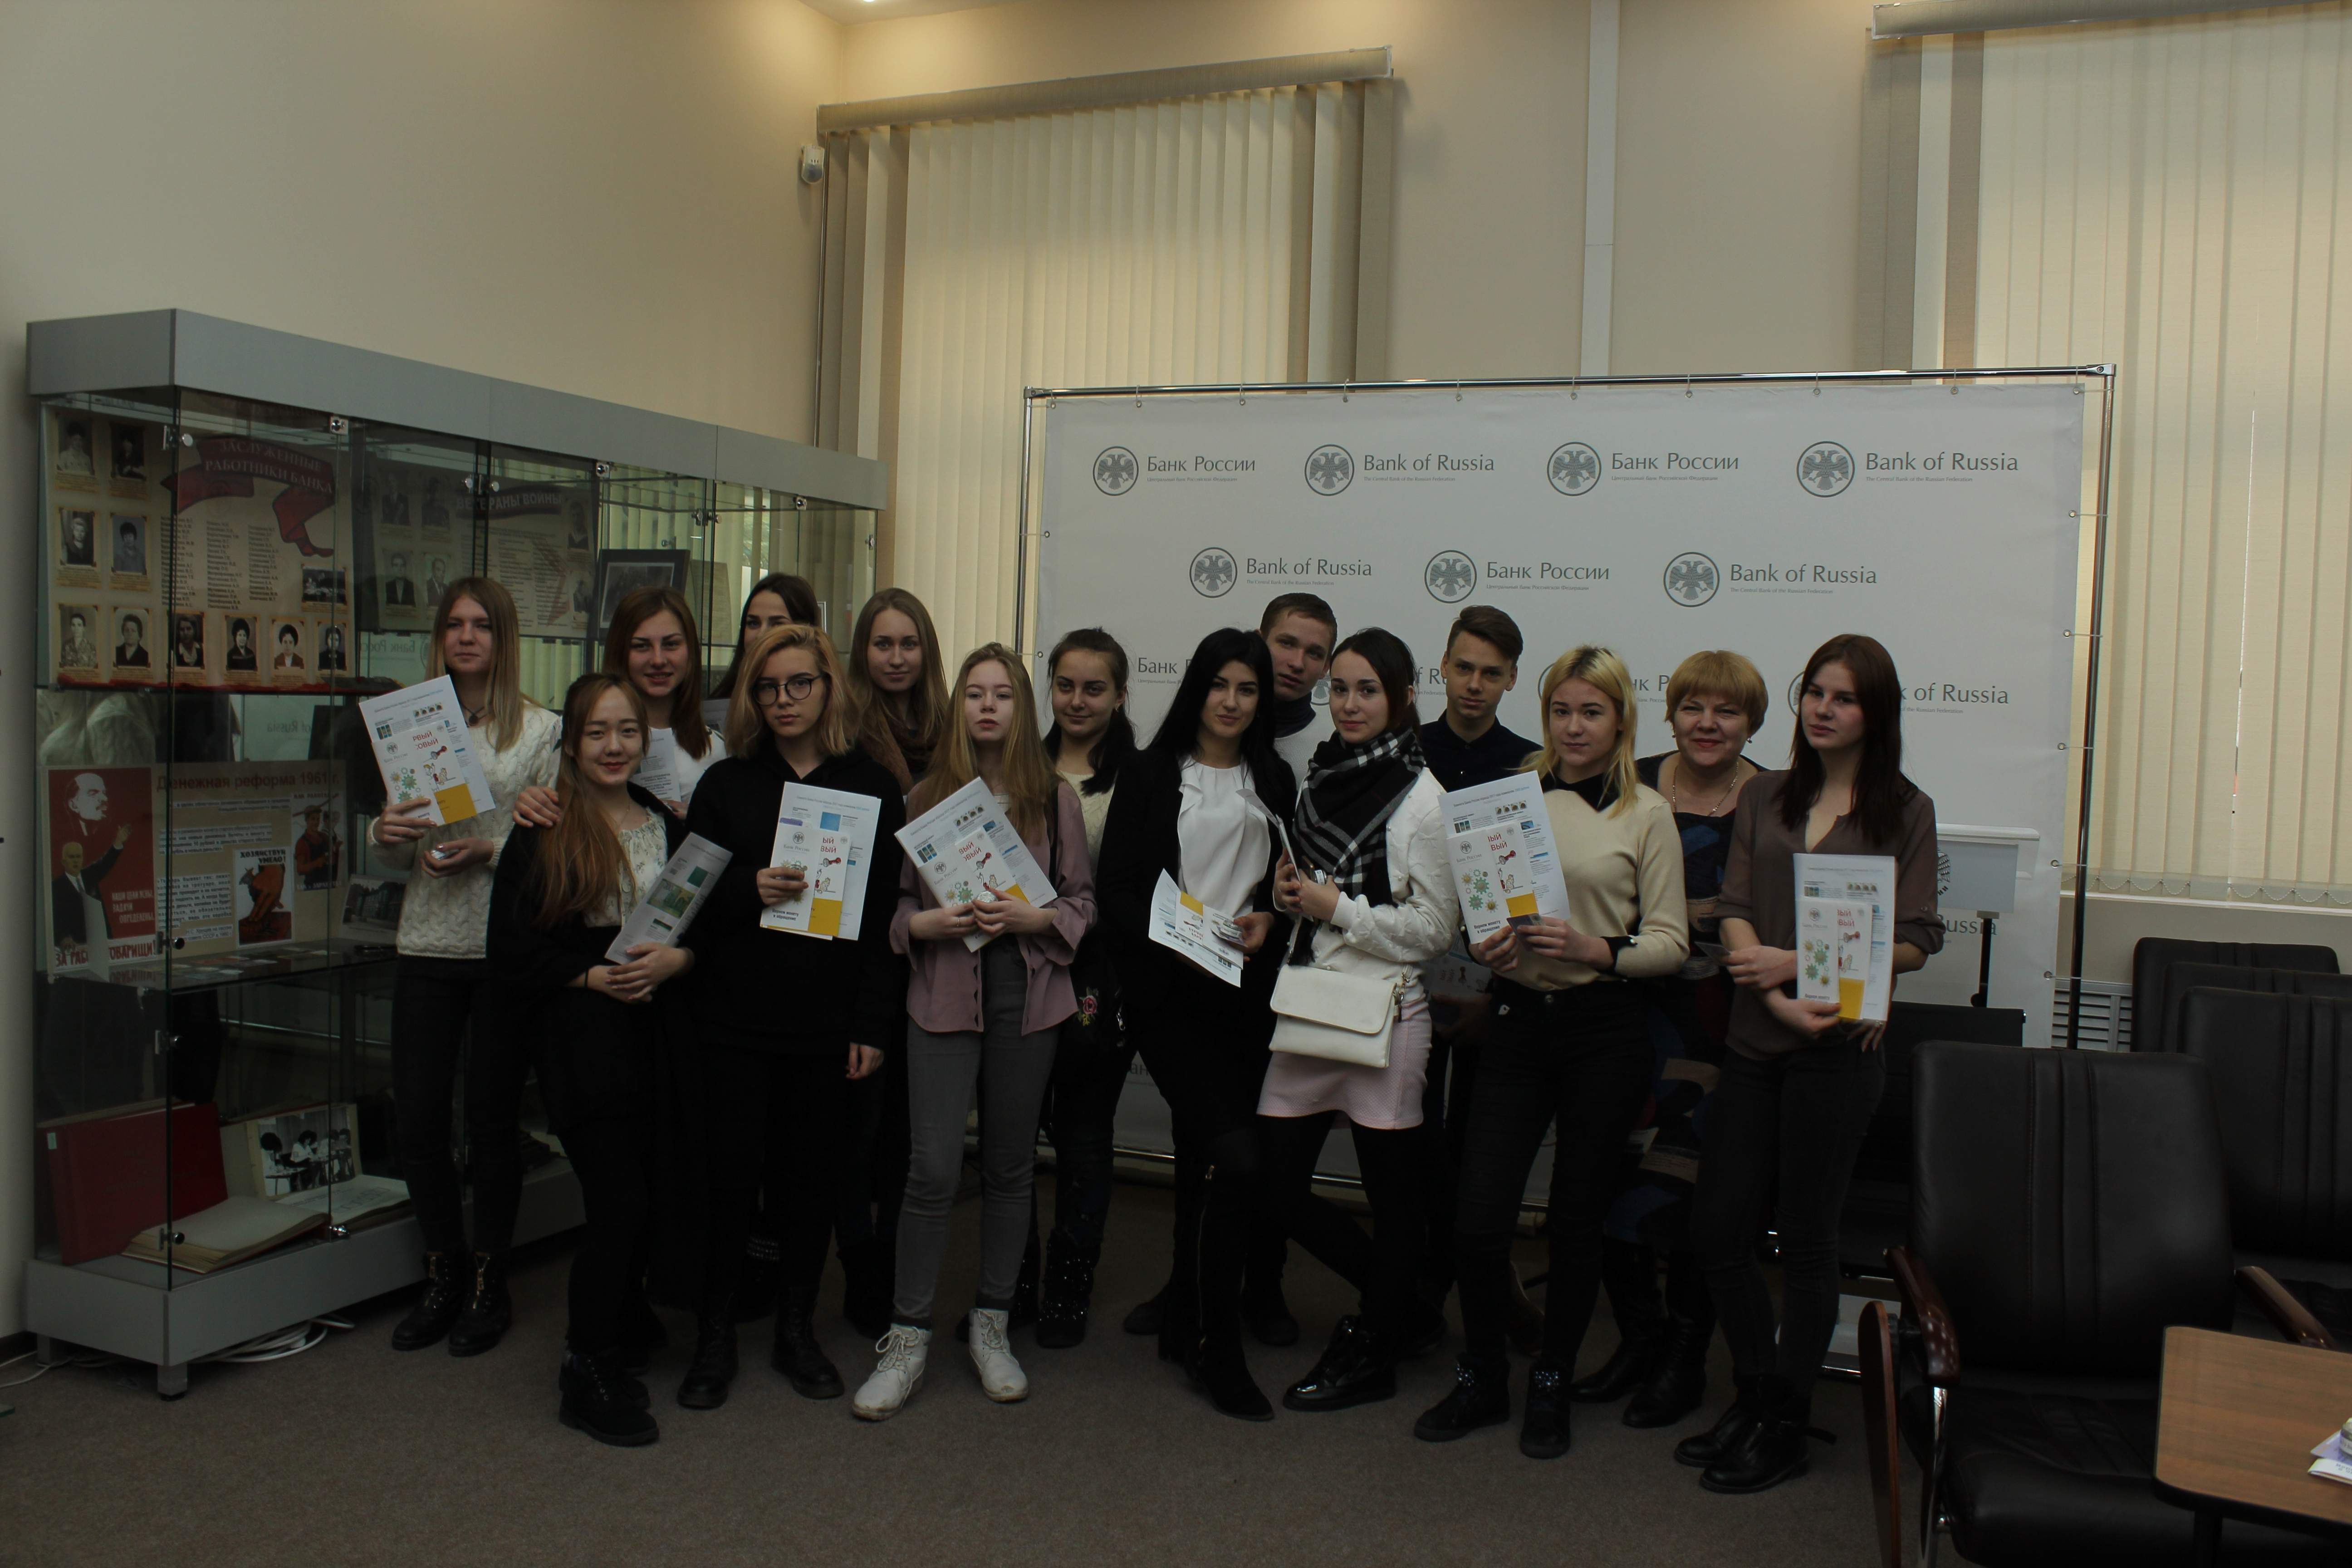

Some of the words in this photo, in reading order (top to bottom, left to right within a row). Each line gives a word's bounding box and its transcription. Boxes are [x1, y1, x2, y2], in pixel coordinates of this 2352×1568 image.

[1147, 456, 1187, 472] Банк
[1195, 456, 1255, 471] России
[1364, 453, 1406, 471] Bank
[1413, 453, 1432, 471] of
[1438, 454, 1494, 471] Russia
[1612, 453, 1658, 470] Банк
[1667, 452, 1739, 470] России
[1866, 451, 1916, 470] Bank
[1923, 451, 1945, 470] of
[1952, 452, 2019, 470] Russia
[205, 459, 288, 480] РАБОТНИКИ
[290, 472, 332, 494] БАНКА
[457, 494, 521, 510] ВЕЕРАНЫ
[1247, 557, 1288, 574] Bank
[1294, 558, 1312, 575] of
[1317, 559, 1372, 576] Russia
[1487, 562, 1532, 578] Банк
[1540, 562, 1609, 580] России
[1730, 564, 1779, 582] Bank
[1785, 564, 1807, 582] of
[1813, 565, 1877, 583] Russia
[1138, 657, 1177, 674] Банк
[1632, 679, 1650, 691] нк
[1914, 682, 1936, 701] of
[1943, 684, 2009, 704] Russia
[413, 730, 432, 742] РВЫЙ
[416, 738, 439, 750] ОВЫЙ
[157, 775, 230, 791] Денежная
[235, 773, 296, 789] реформа
[300, 772, 328, 785] 1961
[240, 849, 286, 858] ХОЗЯЙСТВУЙ
[820, 845, 836, 853] ВЫЙ
[958, 841, 975, 855] ВЫЙ
[1490, 840, 1508, 851] ВЫЙ
[55, 950, 67, 967] ЗА
[70, 950, 88, 966] РАБ
[109, 940, 156, 960] ОВАРИЩИ!
